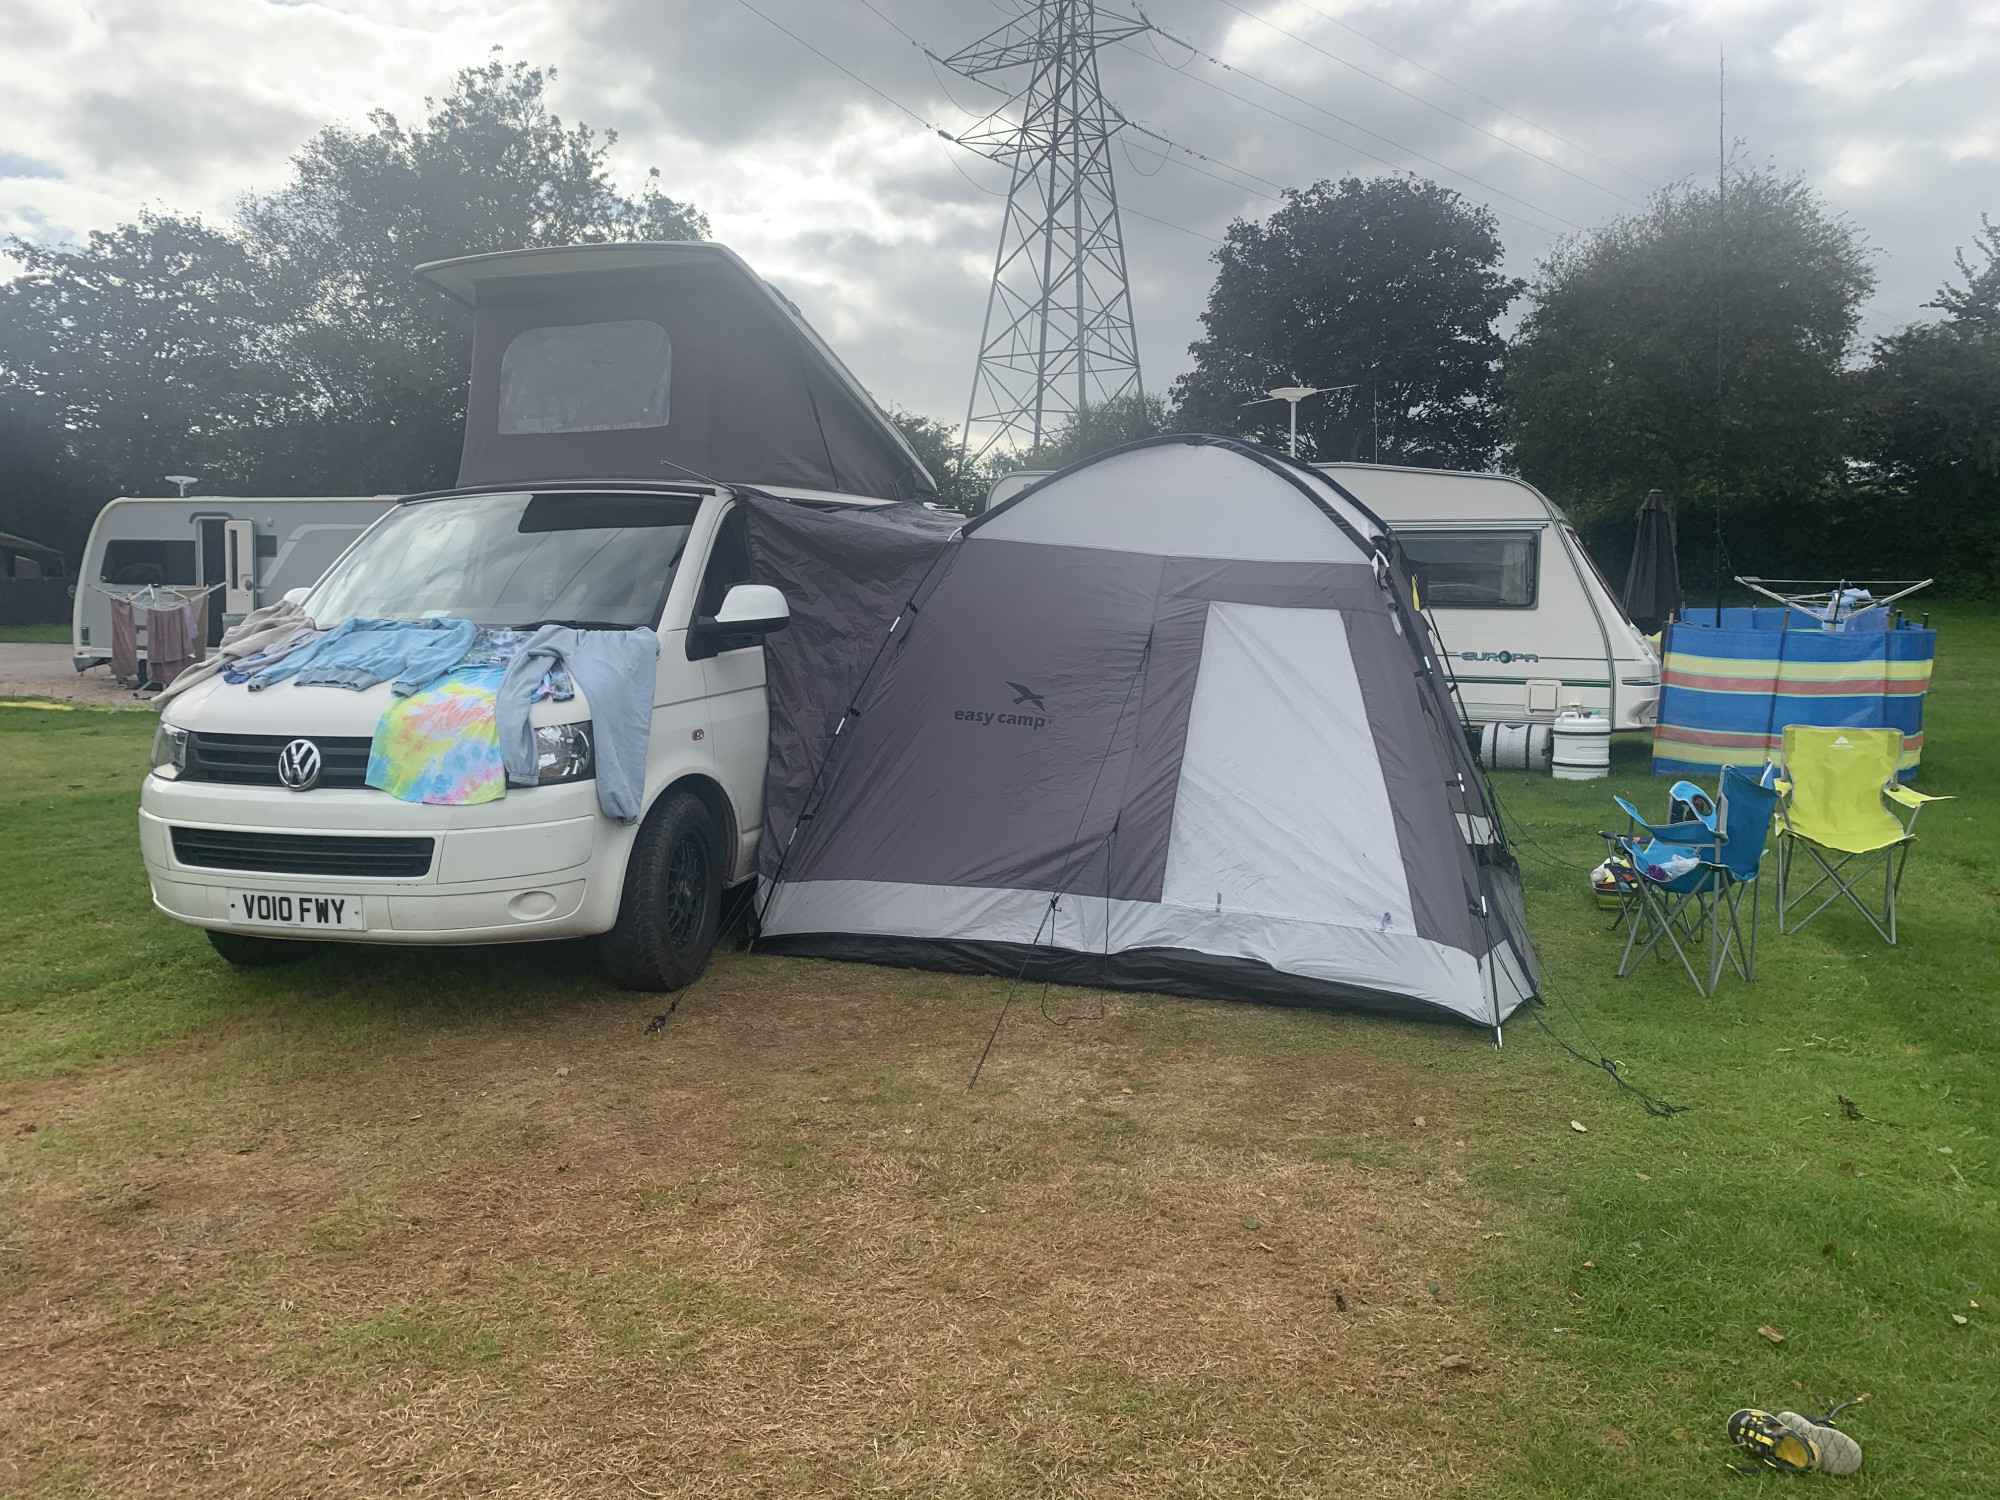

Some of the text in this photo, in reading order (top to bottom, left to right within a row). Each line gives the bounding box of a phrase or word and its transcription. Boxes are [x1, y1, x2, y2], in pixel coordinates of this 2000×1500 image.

[1461, 650, 1539, 664] EUROPA
[954, 709, 1045, 731] easy camp
[242, 893, 345, 924] VO10 FWY
